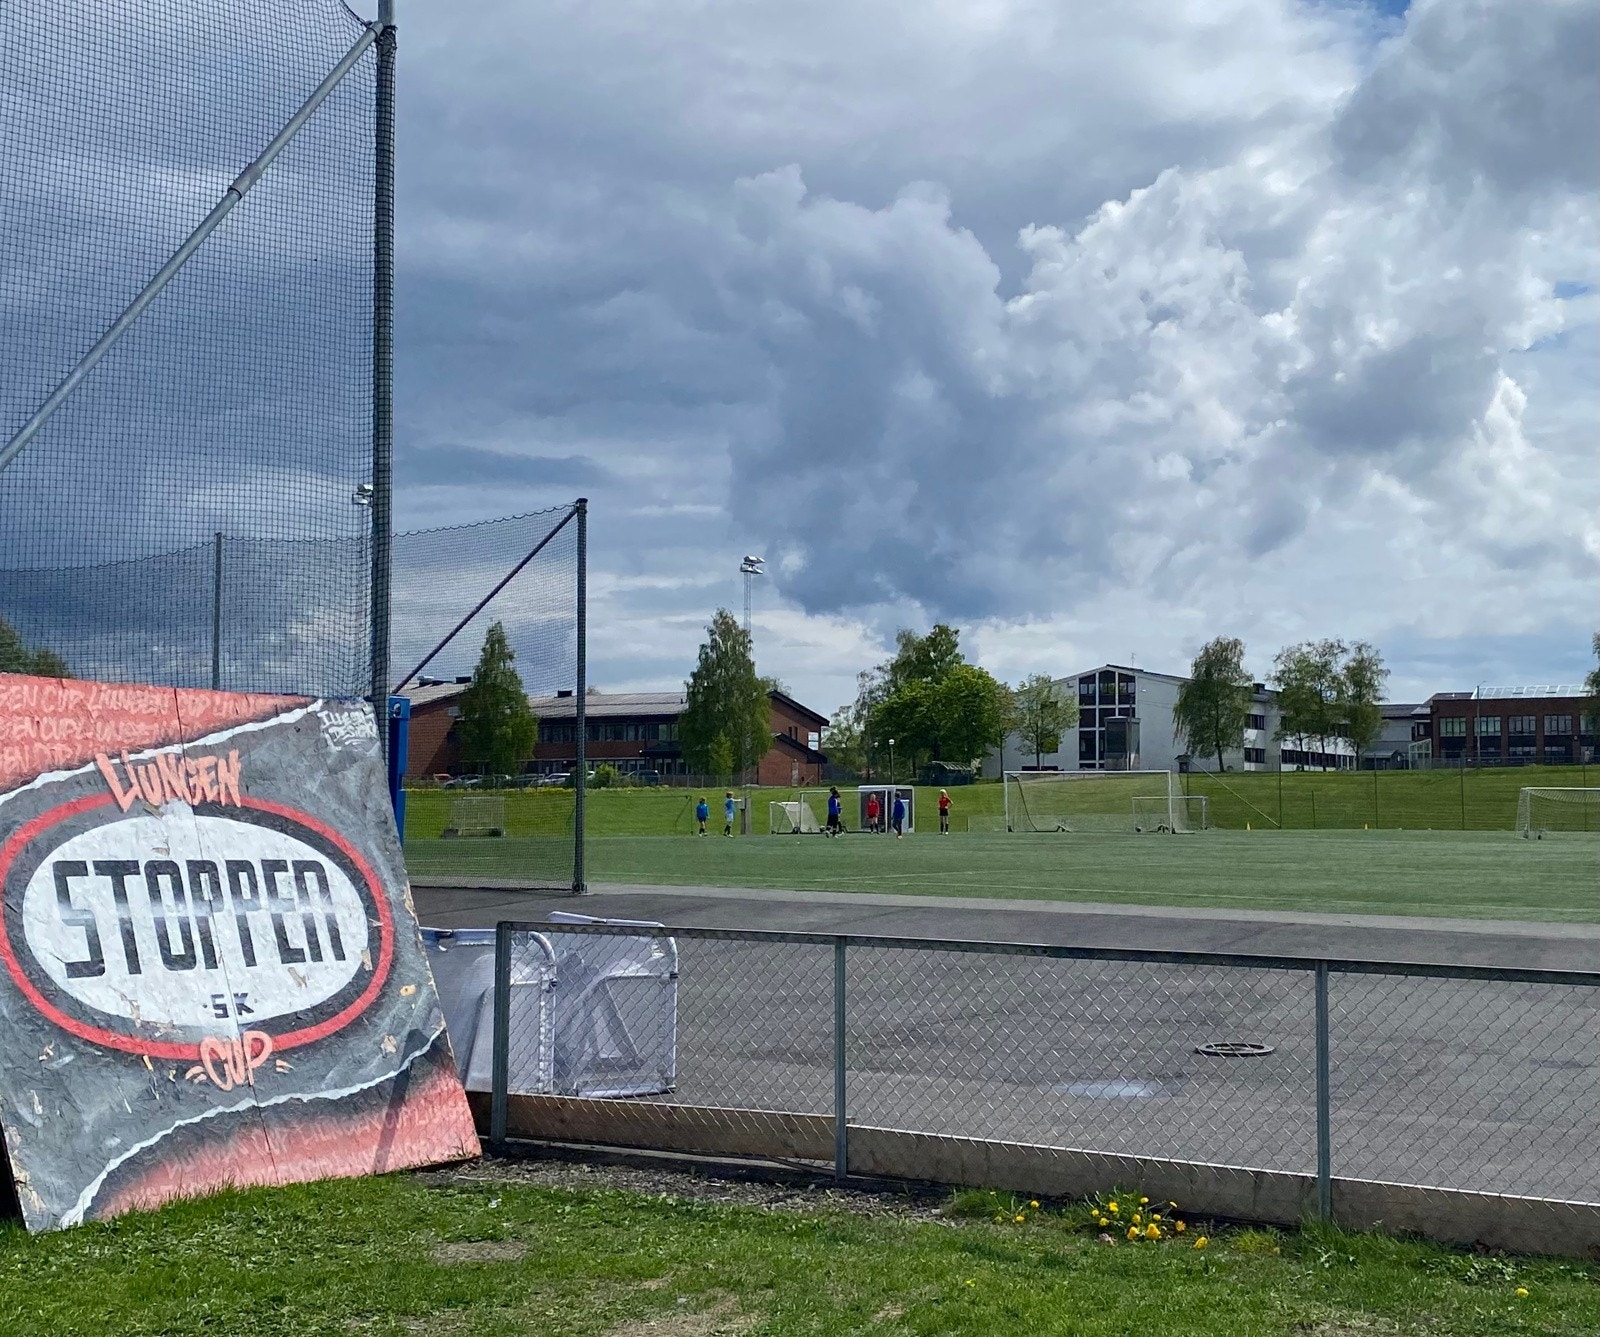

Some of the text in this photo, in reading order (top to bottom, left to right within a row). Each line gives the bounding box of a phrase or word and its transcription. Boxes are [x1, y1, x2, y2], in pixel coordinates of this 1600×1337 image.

[52, 859, 346, 978] STOPPEN
[210, 992, 255, 1018] SK
[200, 1030, 273, 1092] CUP
